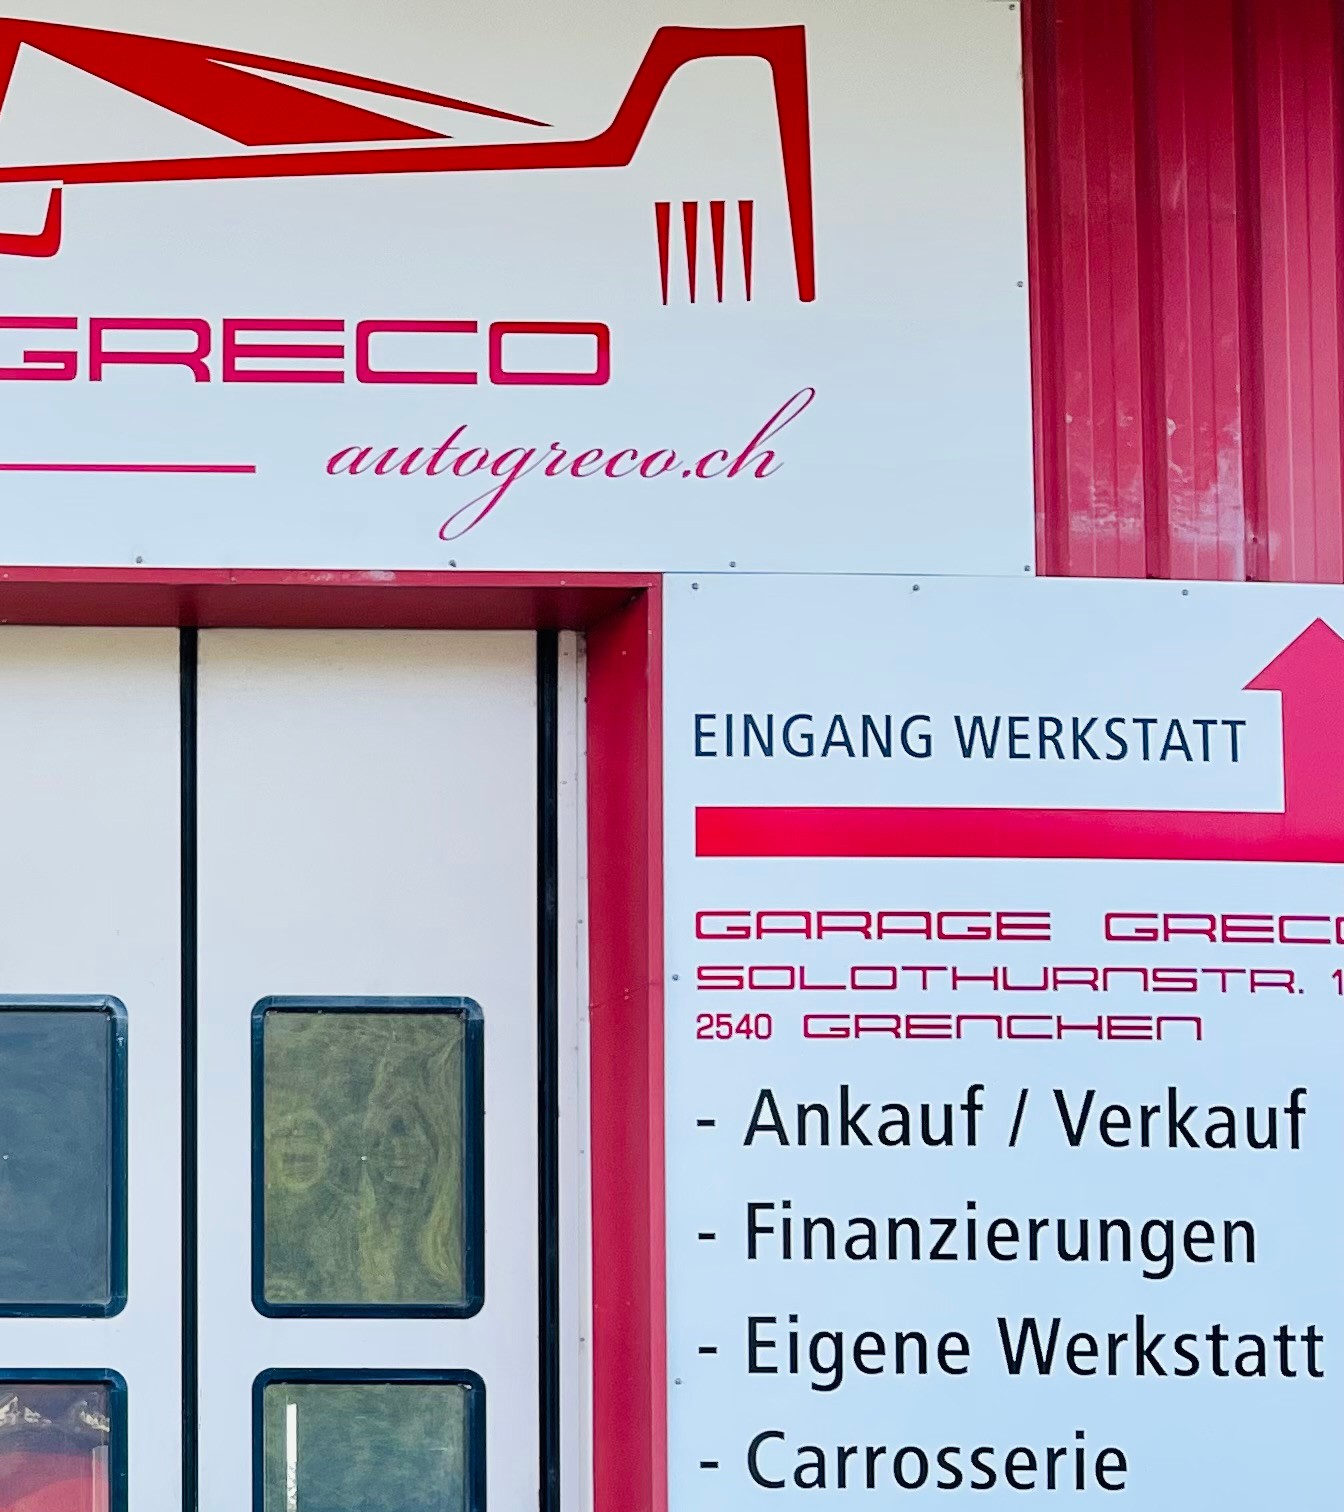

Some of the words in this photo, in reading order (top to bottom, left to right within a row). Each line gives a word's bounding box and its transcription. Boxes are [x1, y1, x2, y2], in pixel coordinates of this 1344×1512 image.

[327, 386, 815, 541] autogreco.ch
[695, 714, 931, 758] EINGANG
[954, 716, 1246, 762] WERKSTATT
[696, 911, 1051, 940] GARAGE
[1105, 913, 1344, 944] GREC
[697, 966, 1303, 993] SOLOTHURNSTR.
[697, 1014, 771, 1039] 2540
[804, 1015, 1201, 1040] GRENCHEN
[744, 1084, 984, 1146] Ankauf
[1053, 1087, 1307, 1149] Verkauf
[748, 1200, 1254, 1279] Finanzierungen
[748, 1314, 969, 1391] Eigene
[997, 1314, 1324, 1377] Werkstatt
[748, 1430, 1127, 1490] Carrosserie
